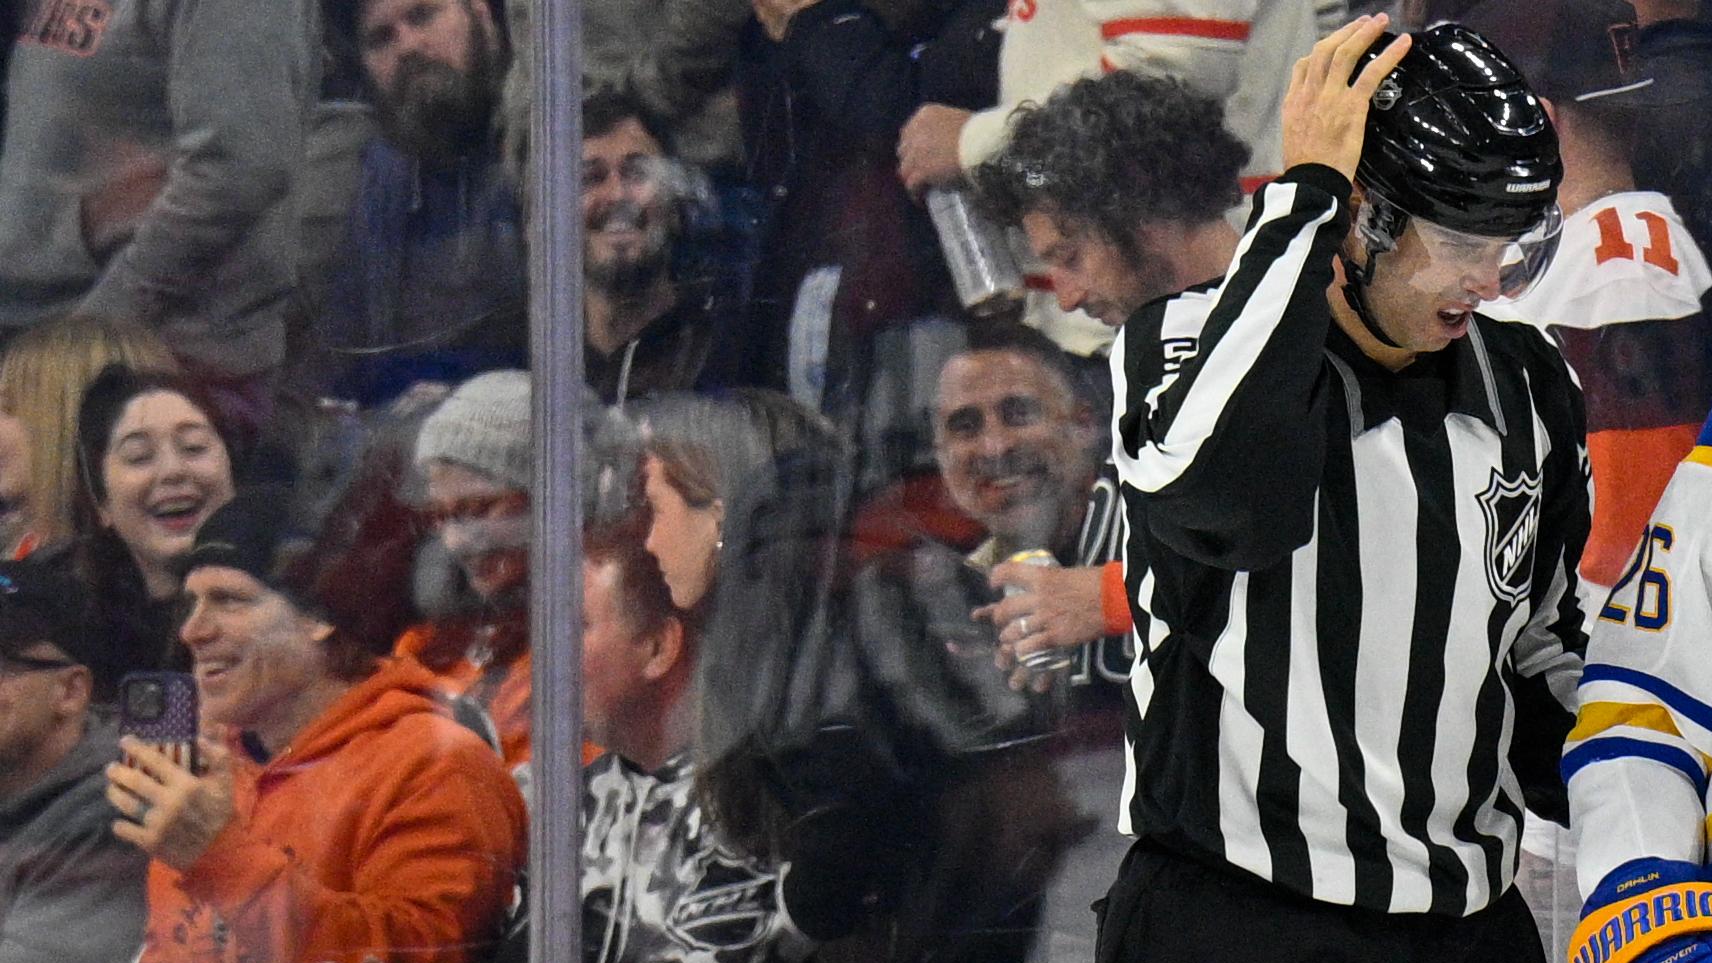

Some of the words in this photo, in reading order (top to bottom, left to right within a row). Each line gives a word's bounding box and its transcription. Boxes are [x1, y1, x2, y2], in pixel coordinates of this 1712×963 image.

[1589, 206, 1679, 276] 11
[1501, 504, 1536, 578] NHL
[1598, 521, 1676, 632] 26
[1616, 872, 1660, 893] DAHLIN
